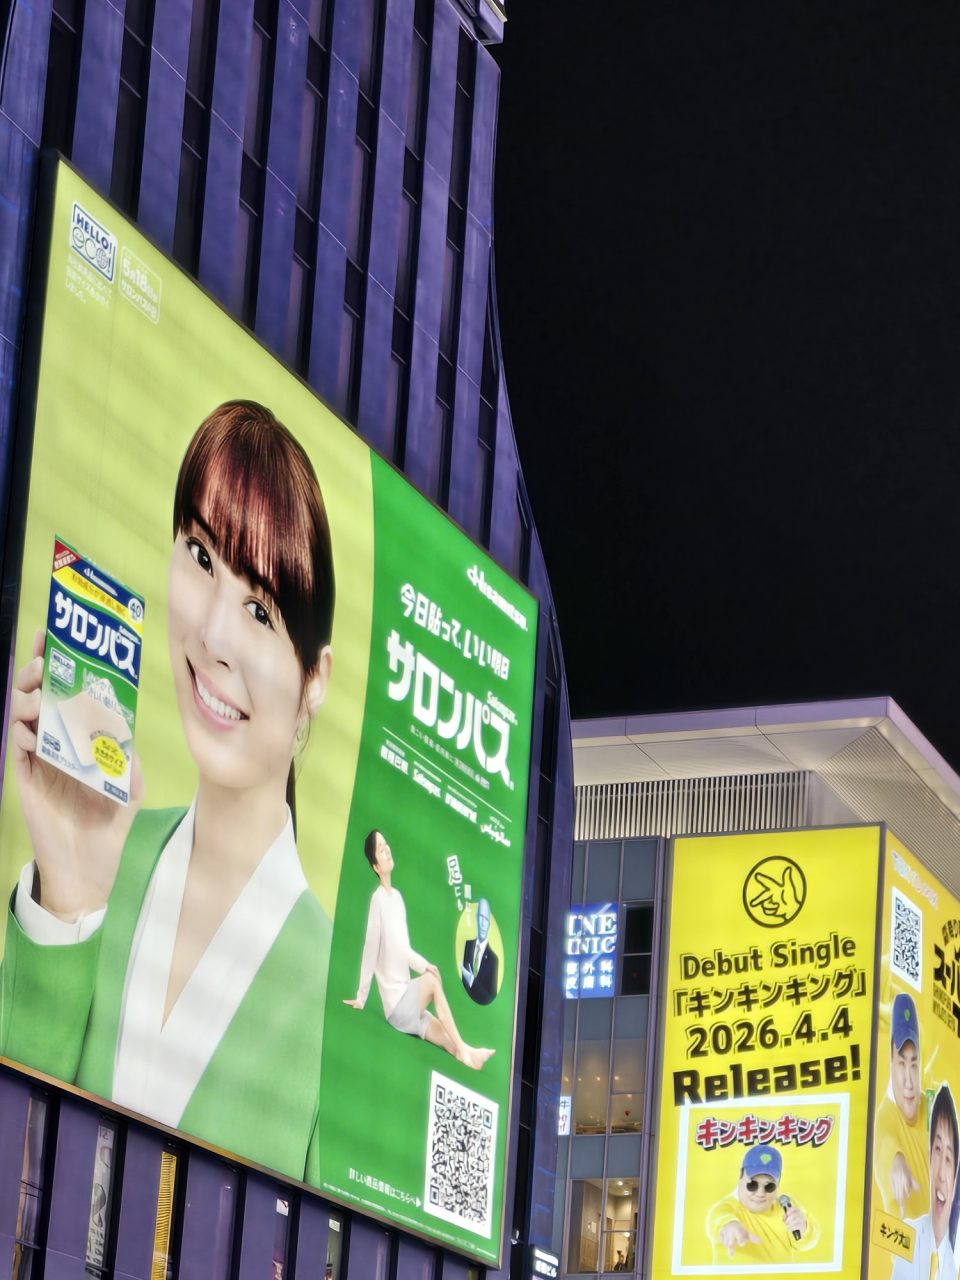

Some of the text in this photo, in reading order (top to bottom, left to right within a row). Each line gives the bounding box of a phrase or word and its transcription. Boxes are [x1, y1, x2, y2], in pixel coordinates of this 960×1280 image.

[55, 591, 138, 680] サロンパス
[387, 629, 514, 791] サロンパス
[680, 932, 857, 981] Debut Single
[673, 968, 866, 1017] 「キンキンキング」
[685, 1005, 853, 1060] 2026.4.4
[672, 1044, 861, 1106] Release!
[695, 1114, 834, 1150] キンキンキング
